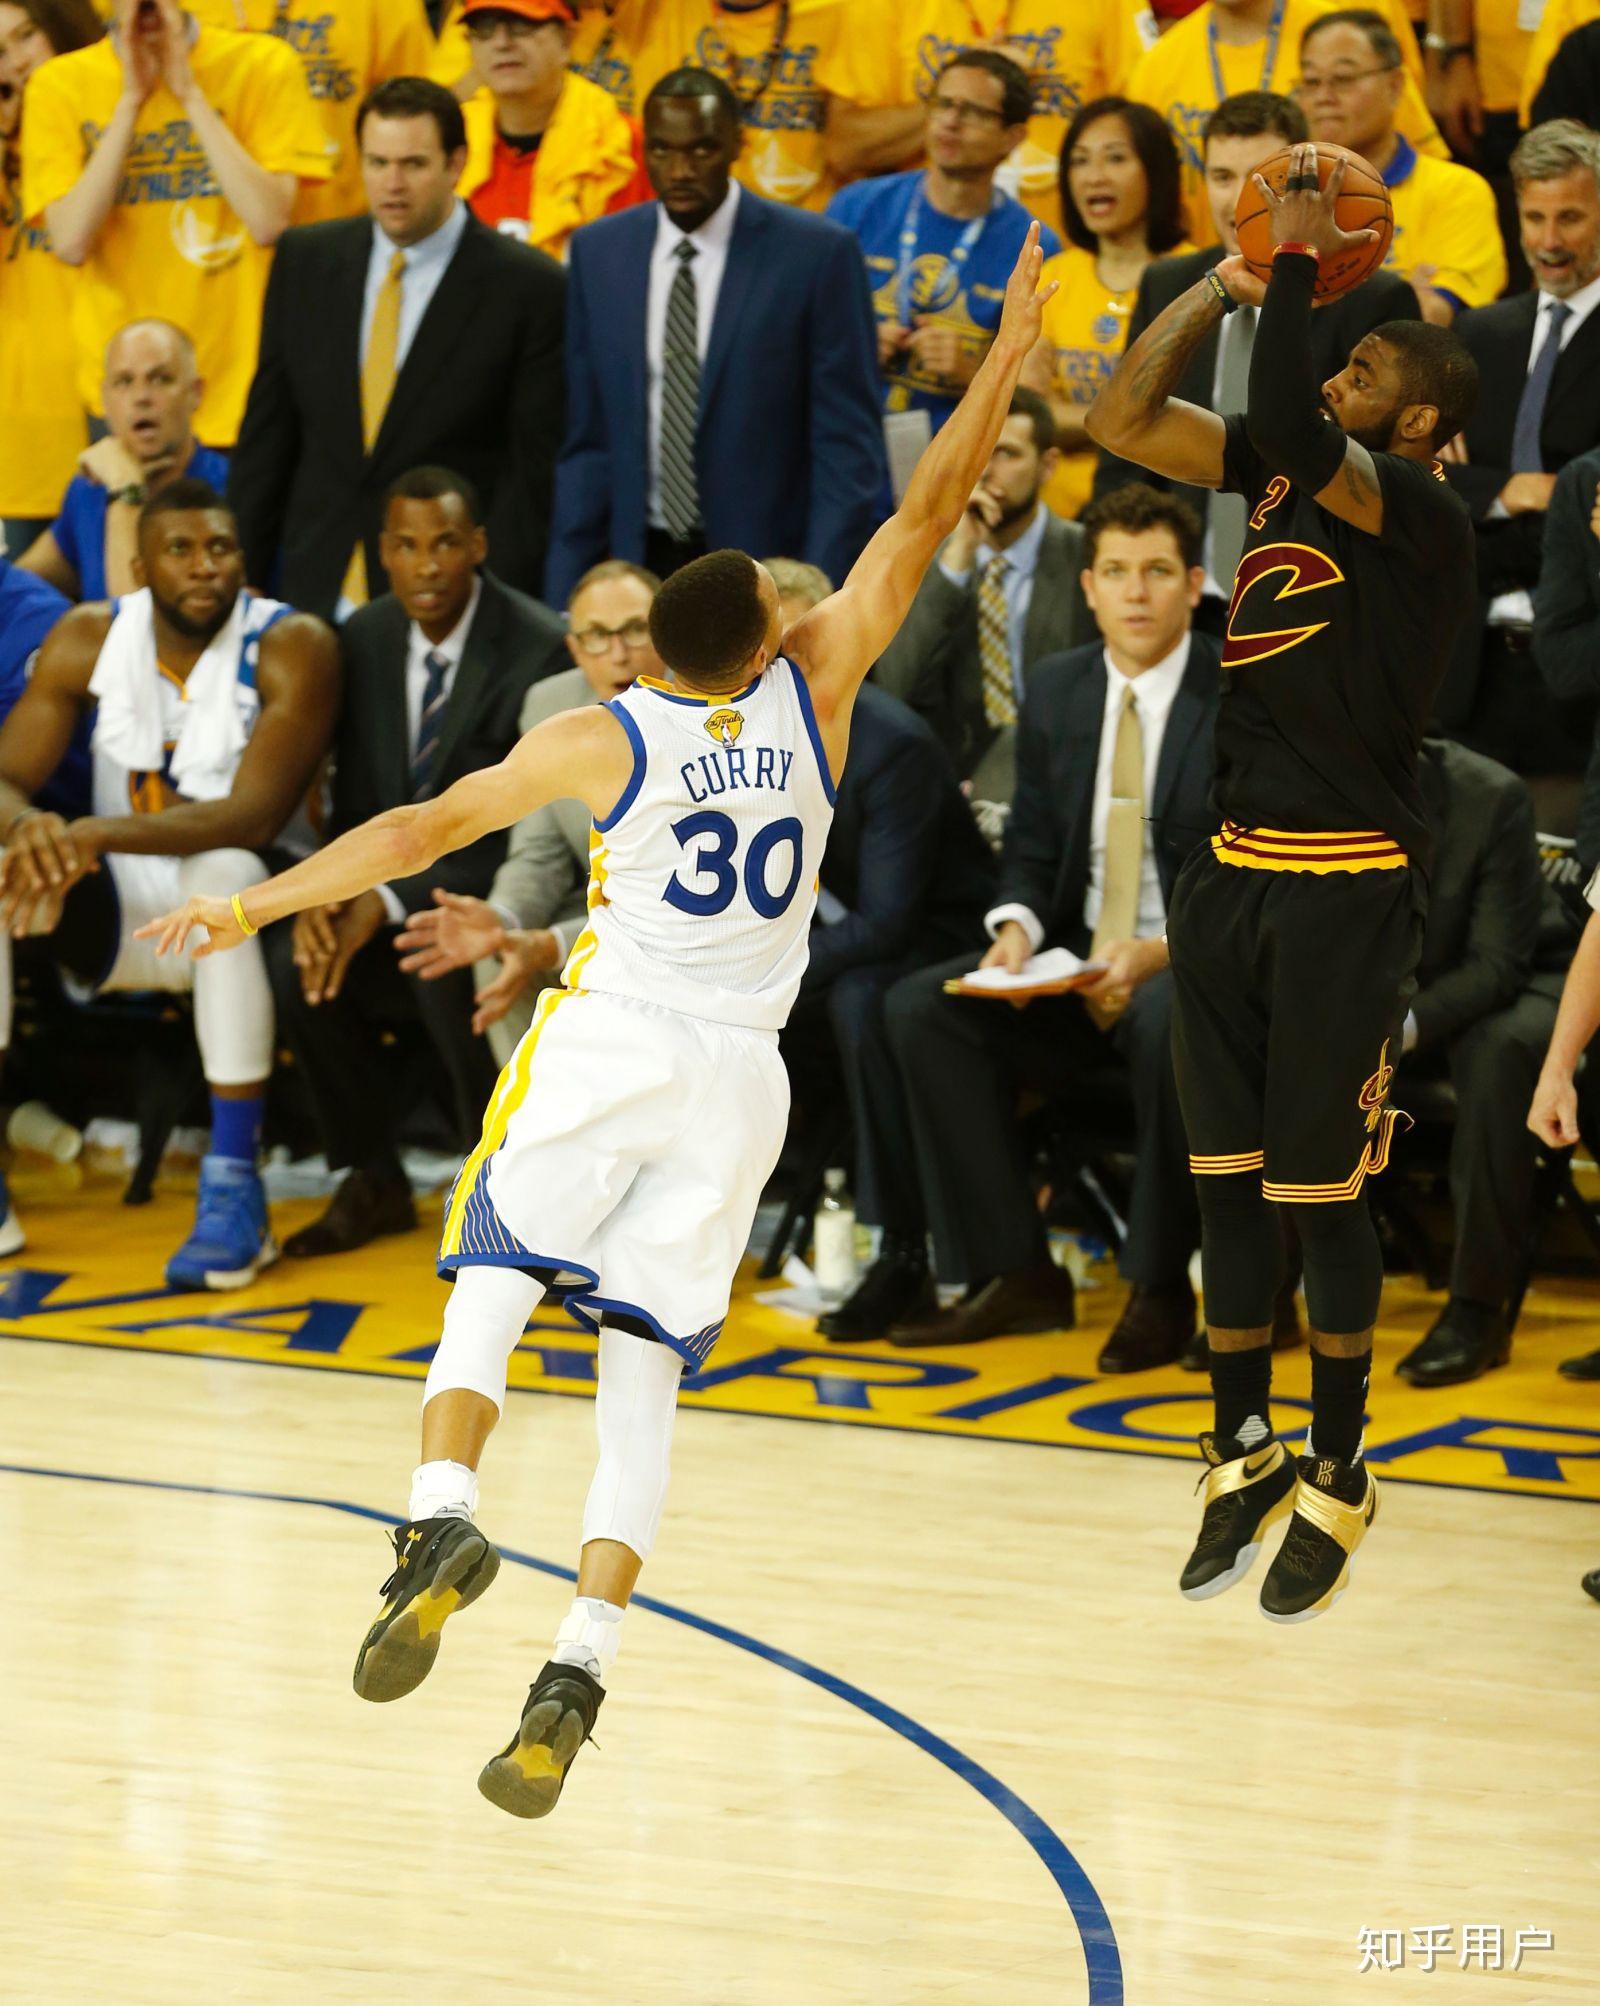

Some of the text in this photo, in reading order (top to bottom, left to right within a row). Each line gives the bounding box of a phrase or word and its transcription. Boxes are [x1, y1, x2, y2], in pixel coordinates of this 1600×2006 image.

[1249, 476, 1290, 531] 2
[681, 746, 793, 803] CURRY
[661, 810, 803, 919] 30
